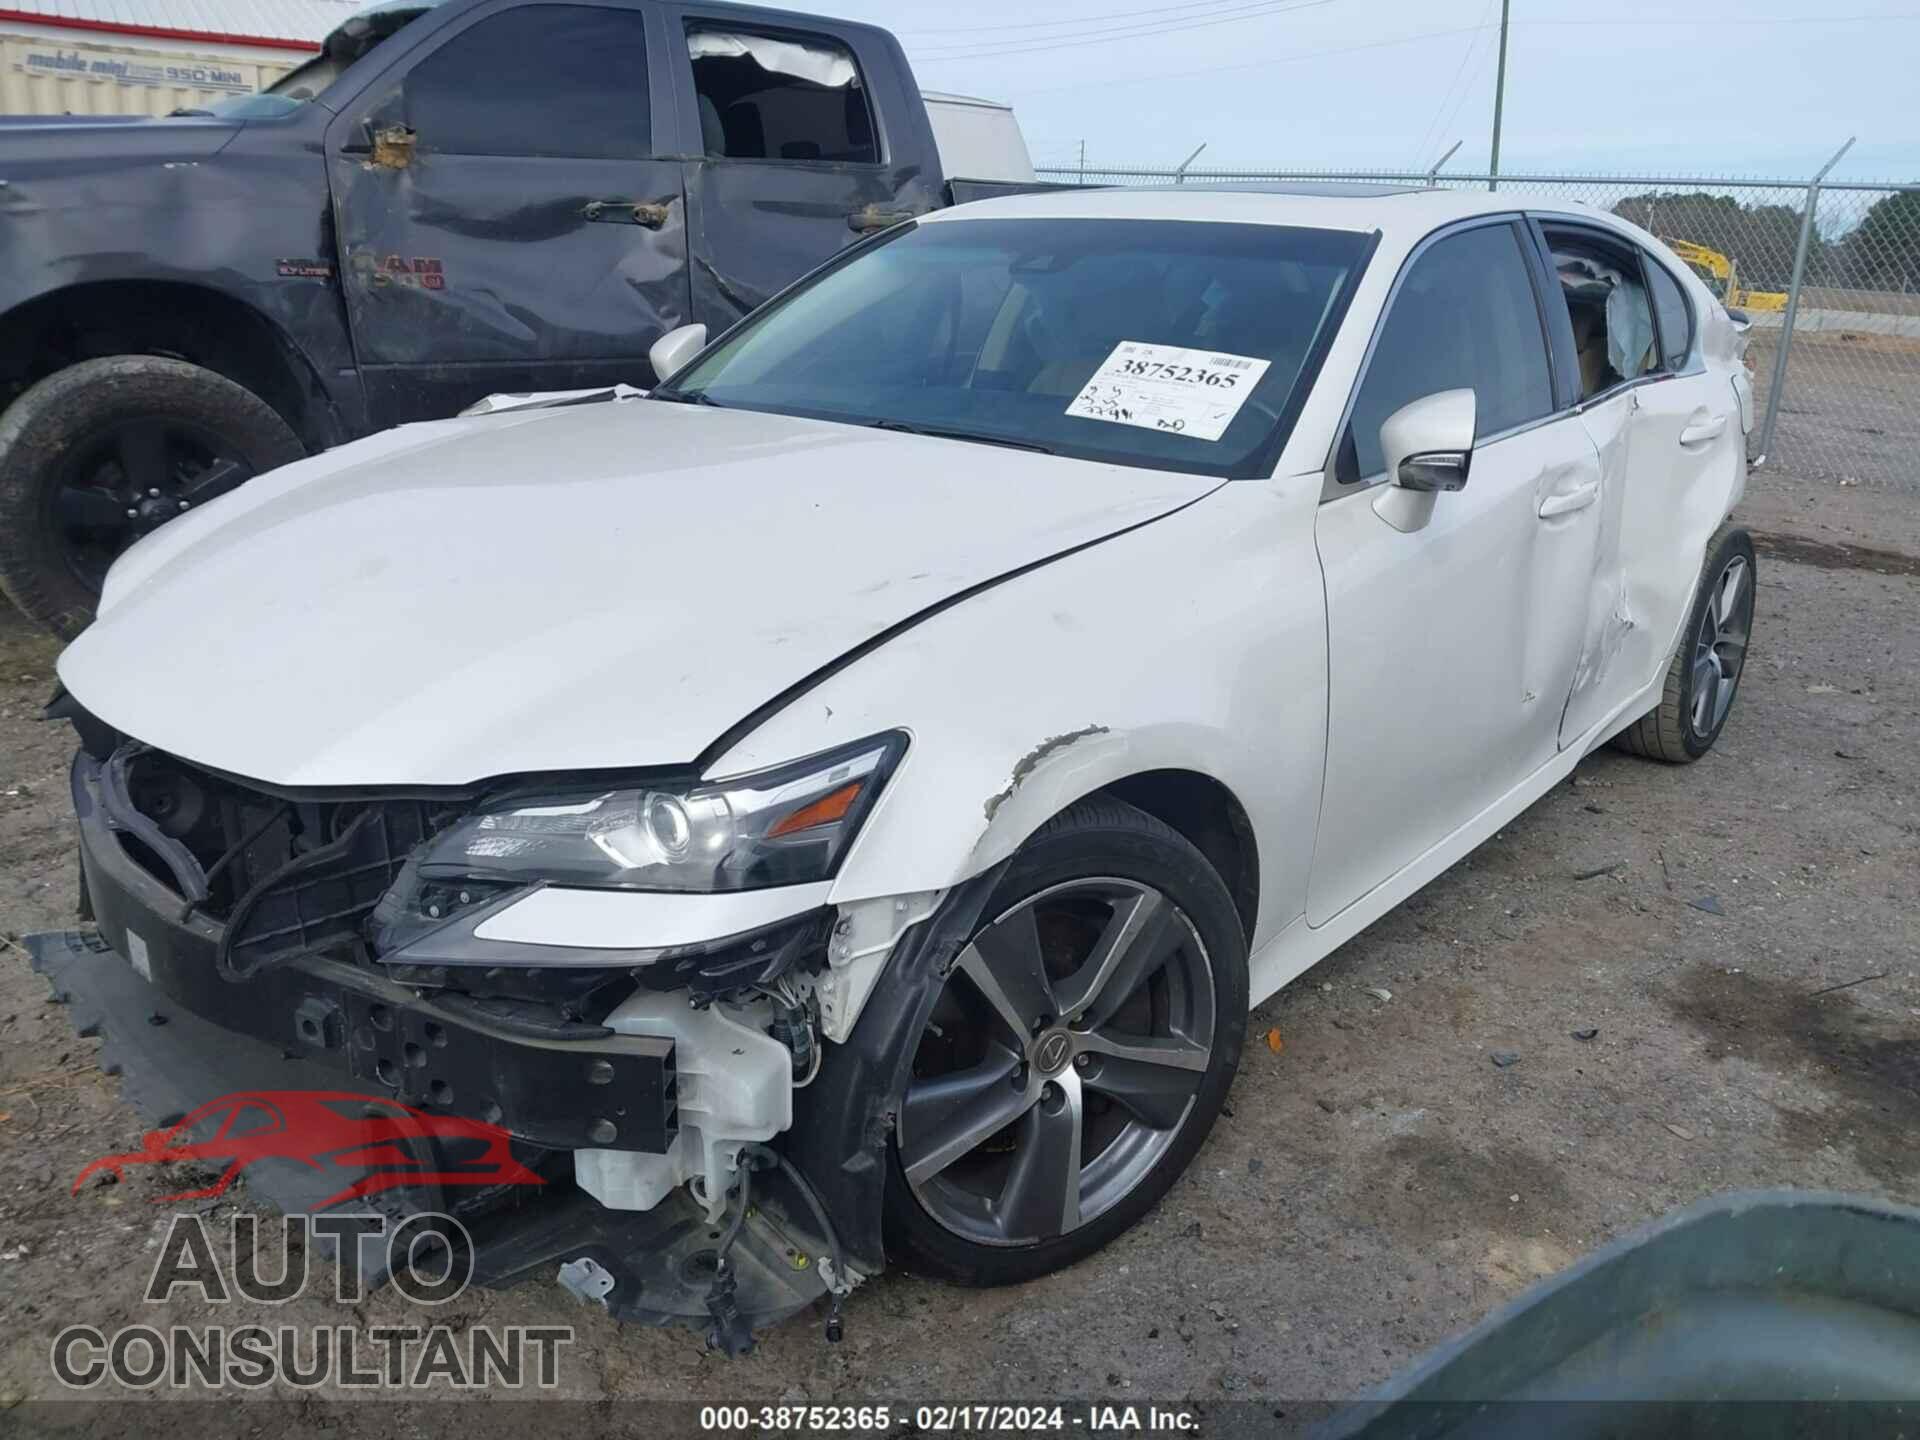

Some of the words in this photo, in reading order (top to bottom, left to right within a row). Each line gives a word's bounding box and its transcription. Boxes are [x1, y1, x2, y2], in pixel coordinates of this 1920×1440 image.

[26, 51, 88, 72] mobile
[90, 59, 129, 76] mini
[1116, 359, 1241, 389] 38752365
